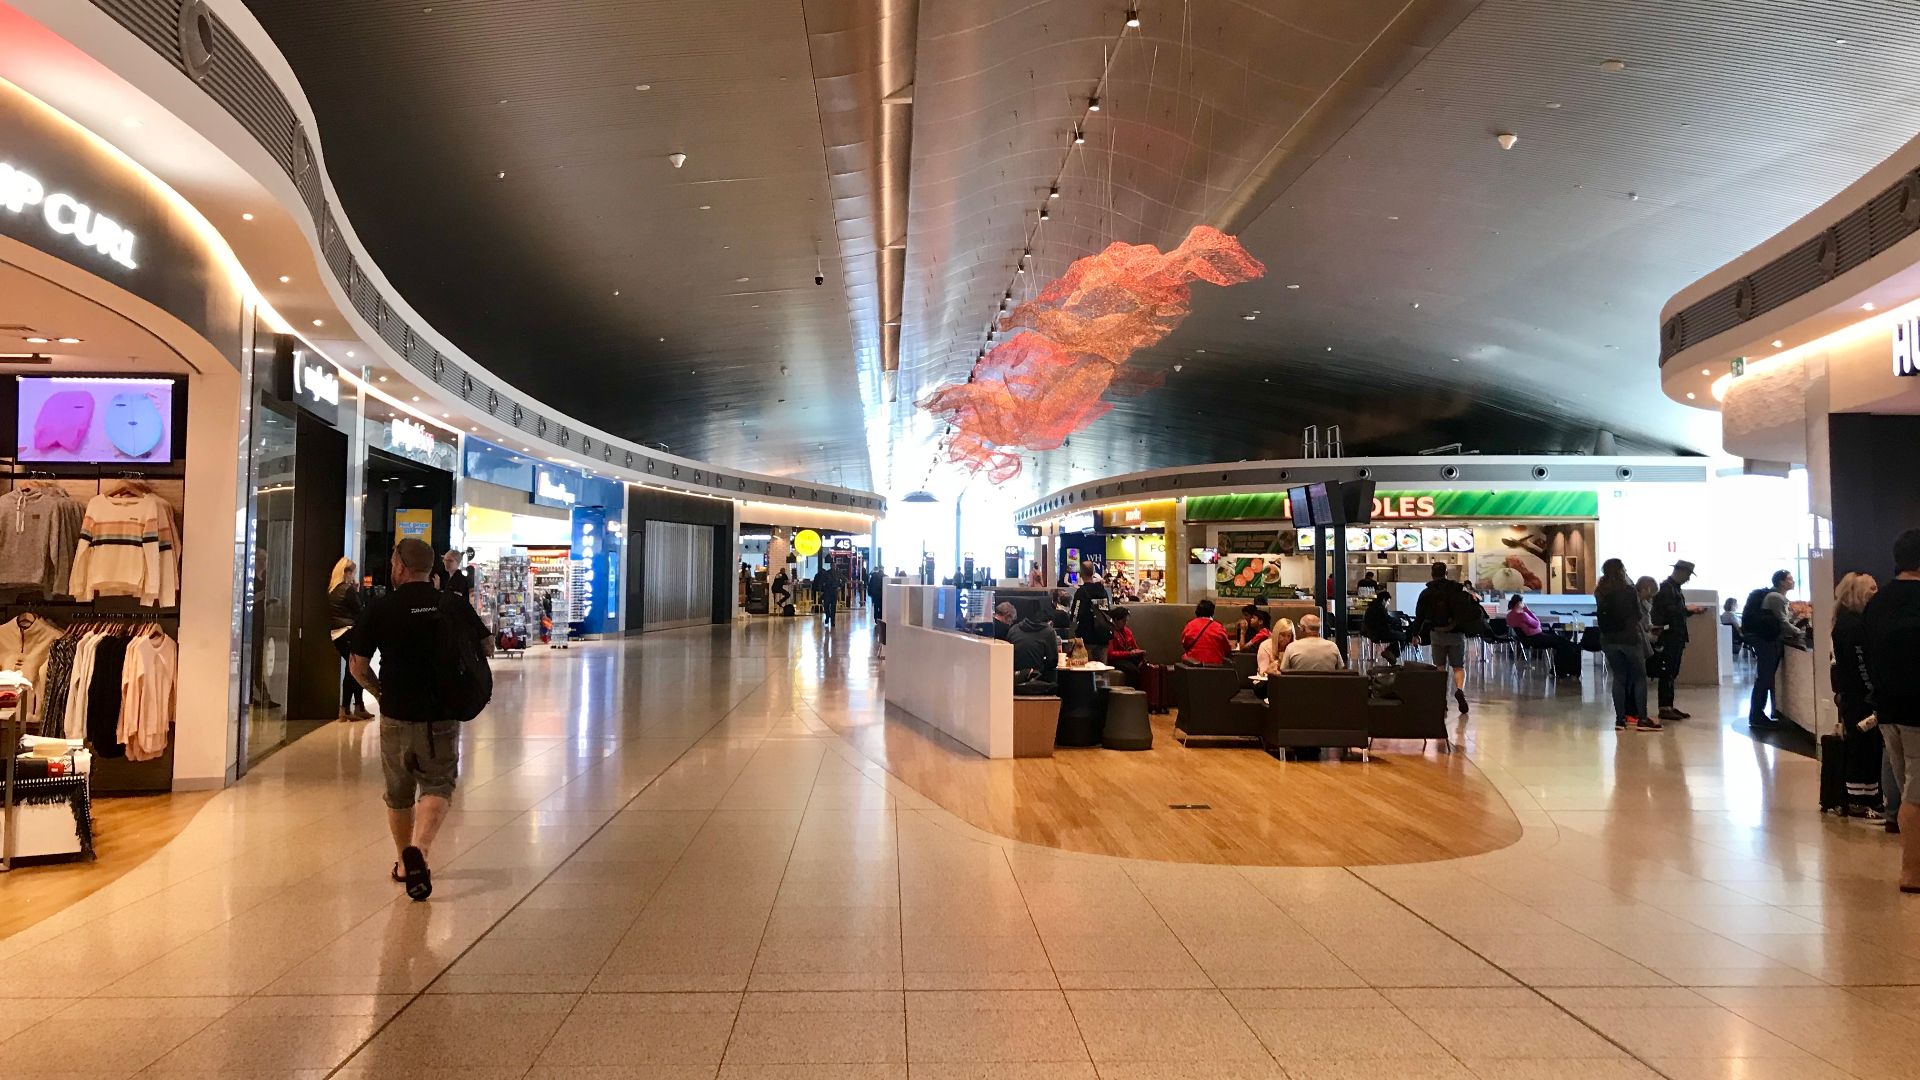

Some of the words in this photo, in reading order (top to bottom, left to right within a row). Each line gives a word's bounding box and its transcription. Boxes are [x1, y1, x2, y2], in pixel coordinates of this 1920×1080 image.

[44, 193, 137, 270] CURL
[1284, 496, 1435, 518] DLES
[836, 539, 850, 549] 45
[1086, 553, 1102, 562] WH
